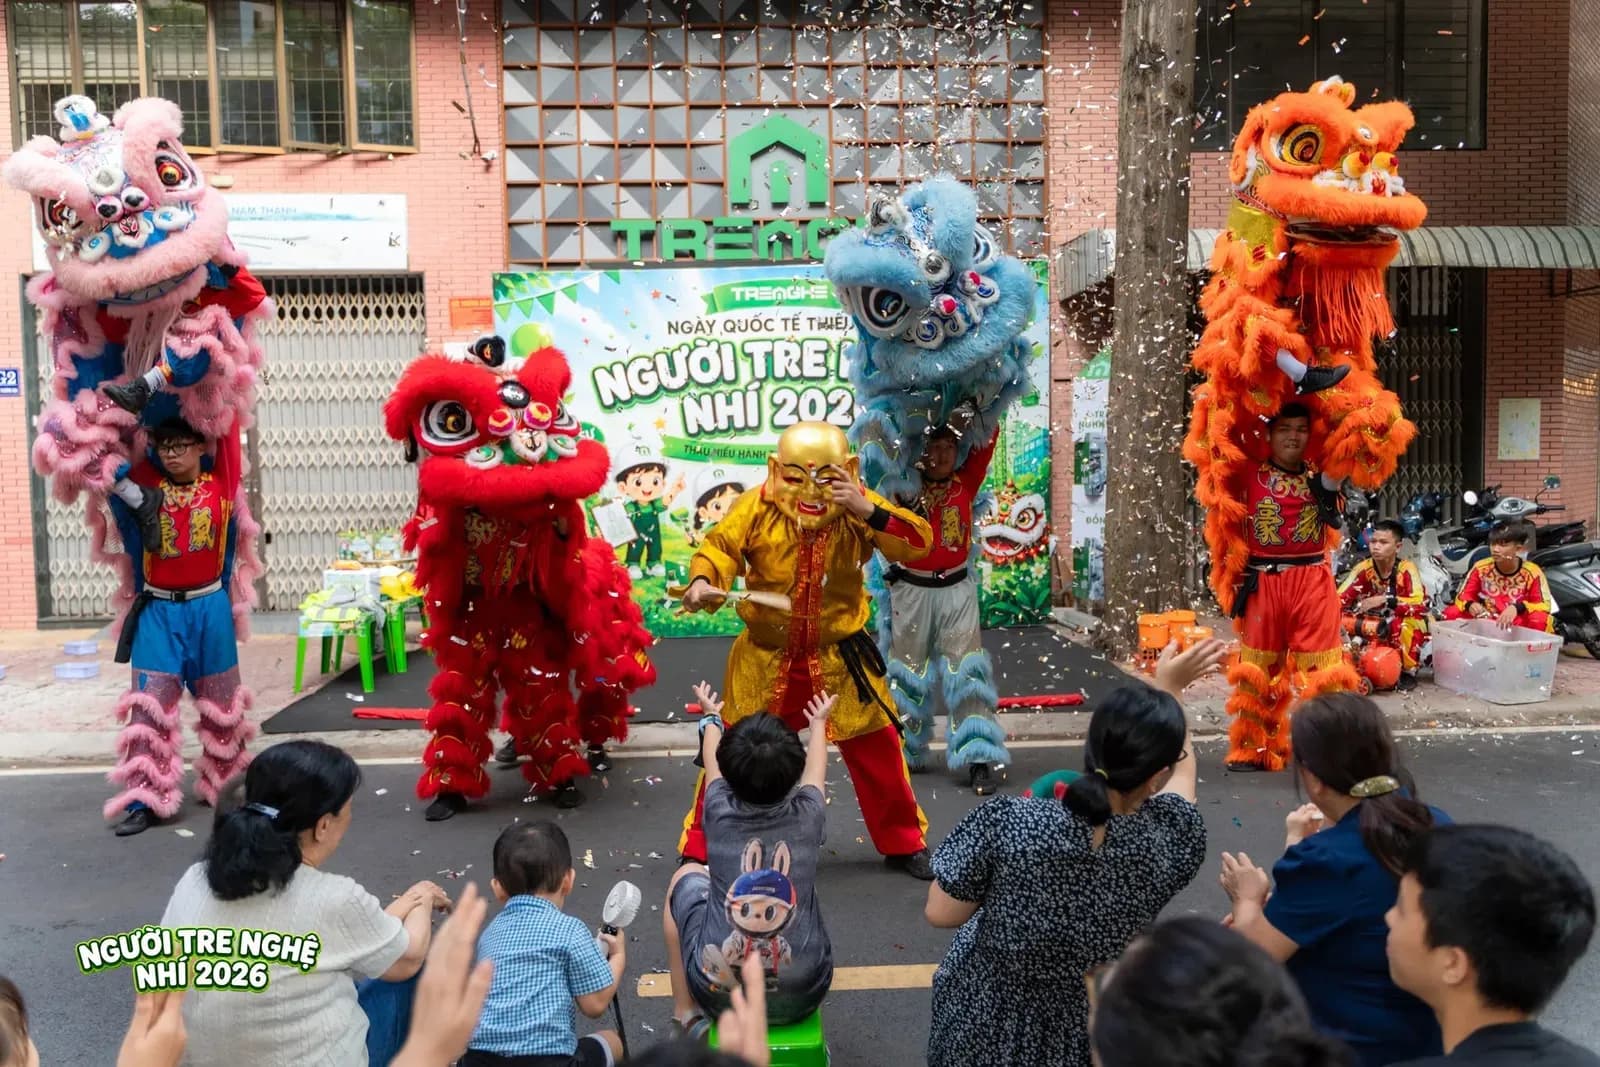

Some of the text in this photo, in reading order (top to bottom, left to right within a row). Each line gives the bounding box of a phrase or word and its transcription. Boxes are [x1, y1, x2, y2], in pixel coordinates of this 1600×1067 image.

[667, 316, 717, 335] NGÀY
[722, 312, 774, 334] QUỐC
[781, 311, 801, 331] TẾ
[593, 338, 736, 407] NGƯỜI
[743, 340, 828, 379] TRE
[683, 382, 855, 435] NHÍ 202
